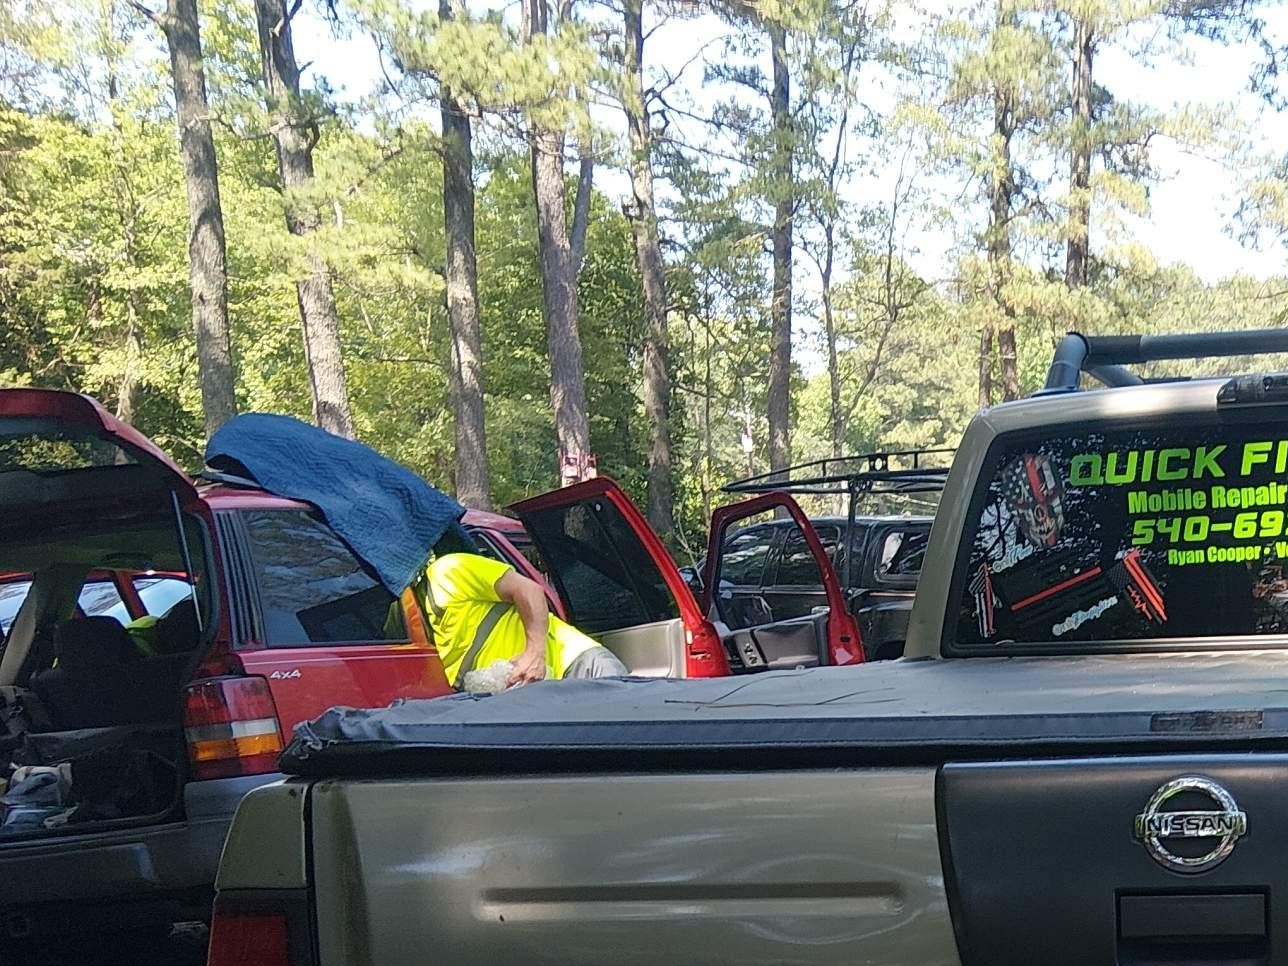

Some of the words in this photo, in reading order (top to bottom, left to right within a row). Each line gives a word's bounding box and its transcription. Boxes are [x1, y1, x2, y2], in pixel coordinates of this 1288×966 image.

[1070, 445, 1226, 486] QUICK
[1128, 488, 1206, 514] Mobile
[1211, 483, 1287, 508] Repair
[1168, 548, 1205, 566] Ryan
[1207, 544, 1261, 564] Cooper
[1149, 816, 1233, 832] NISSAN
